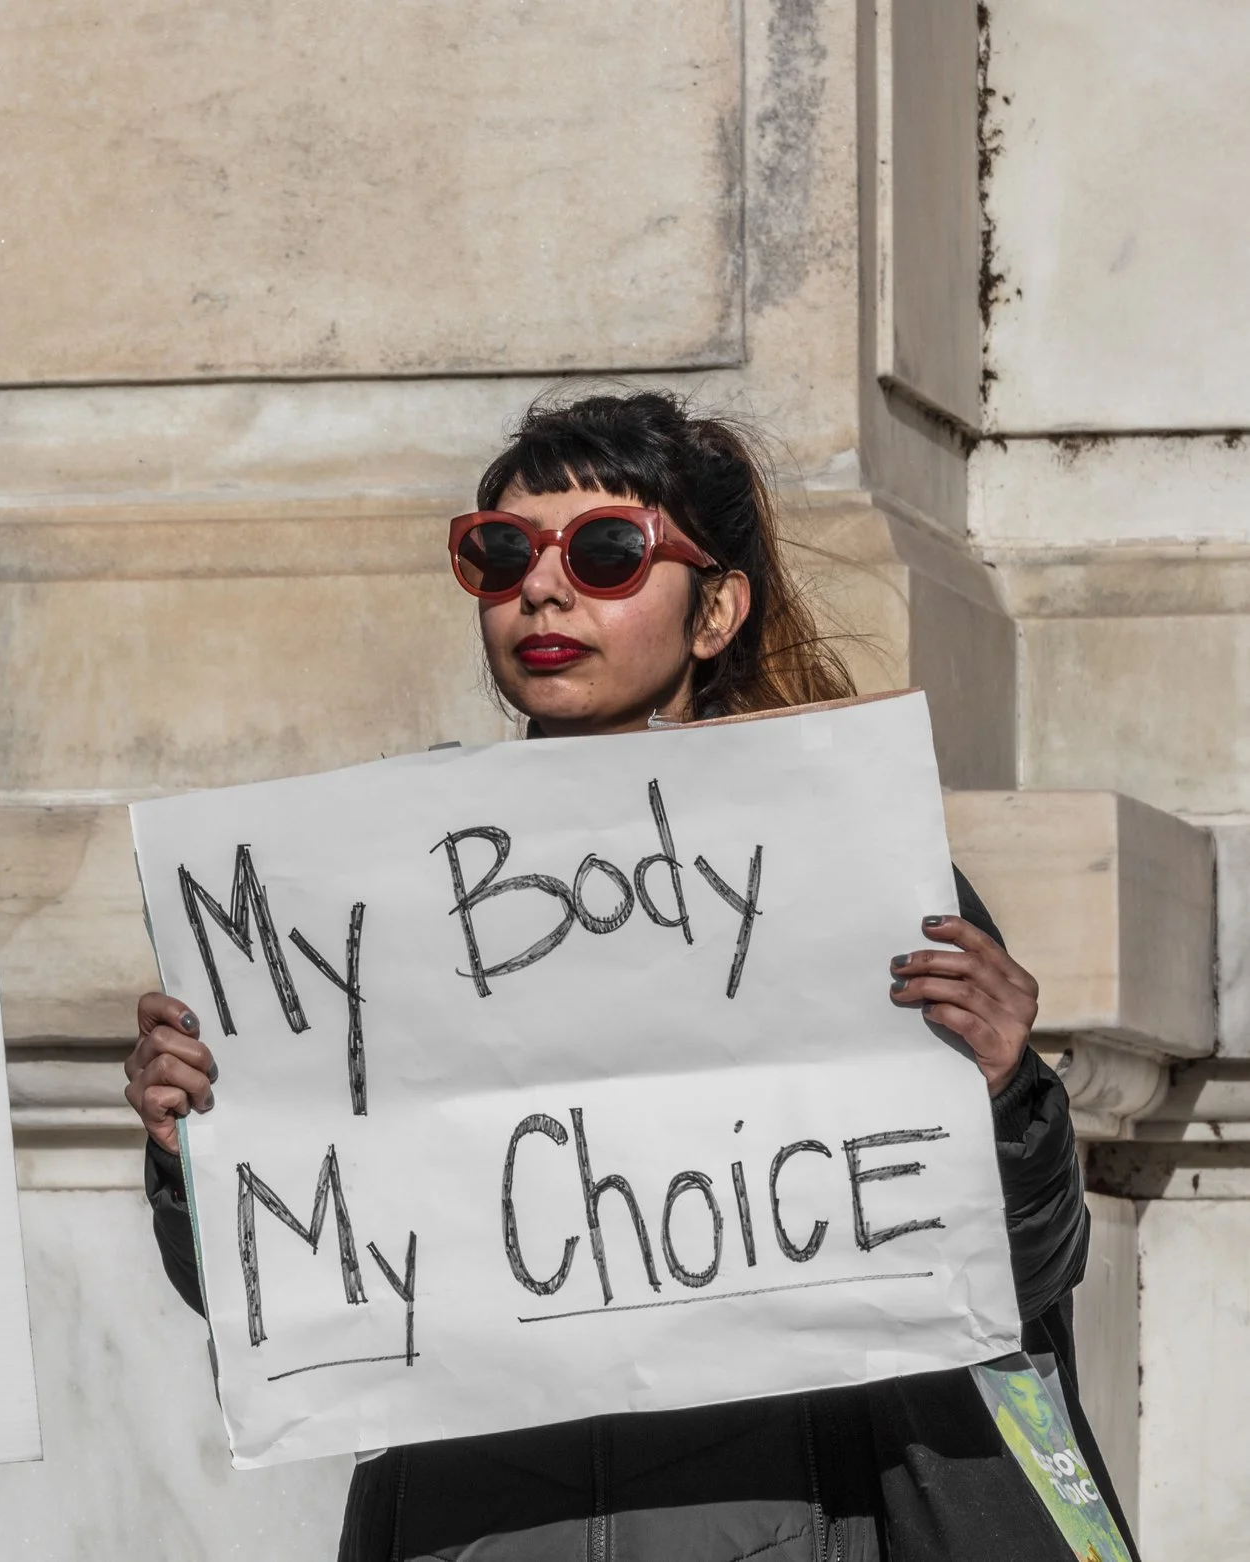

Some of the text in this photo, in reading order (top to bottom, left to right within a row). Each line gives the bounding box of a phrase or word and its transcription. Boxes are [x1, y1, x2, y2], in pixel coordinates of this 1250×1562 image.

[178, 778, 763, 1117] My Body
[237, 1143, 419, 1367] My
